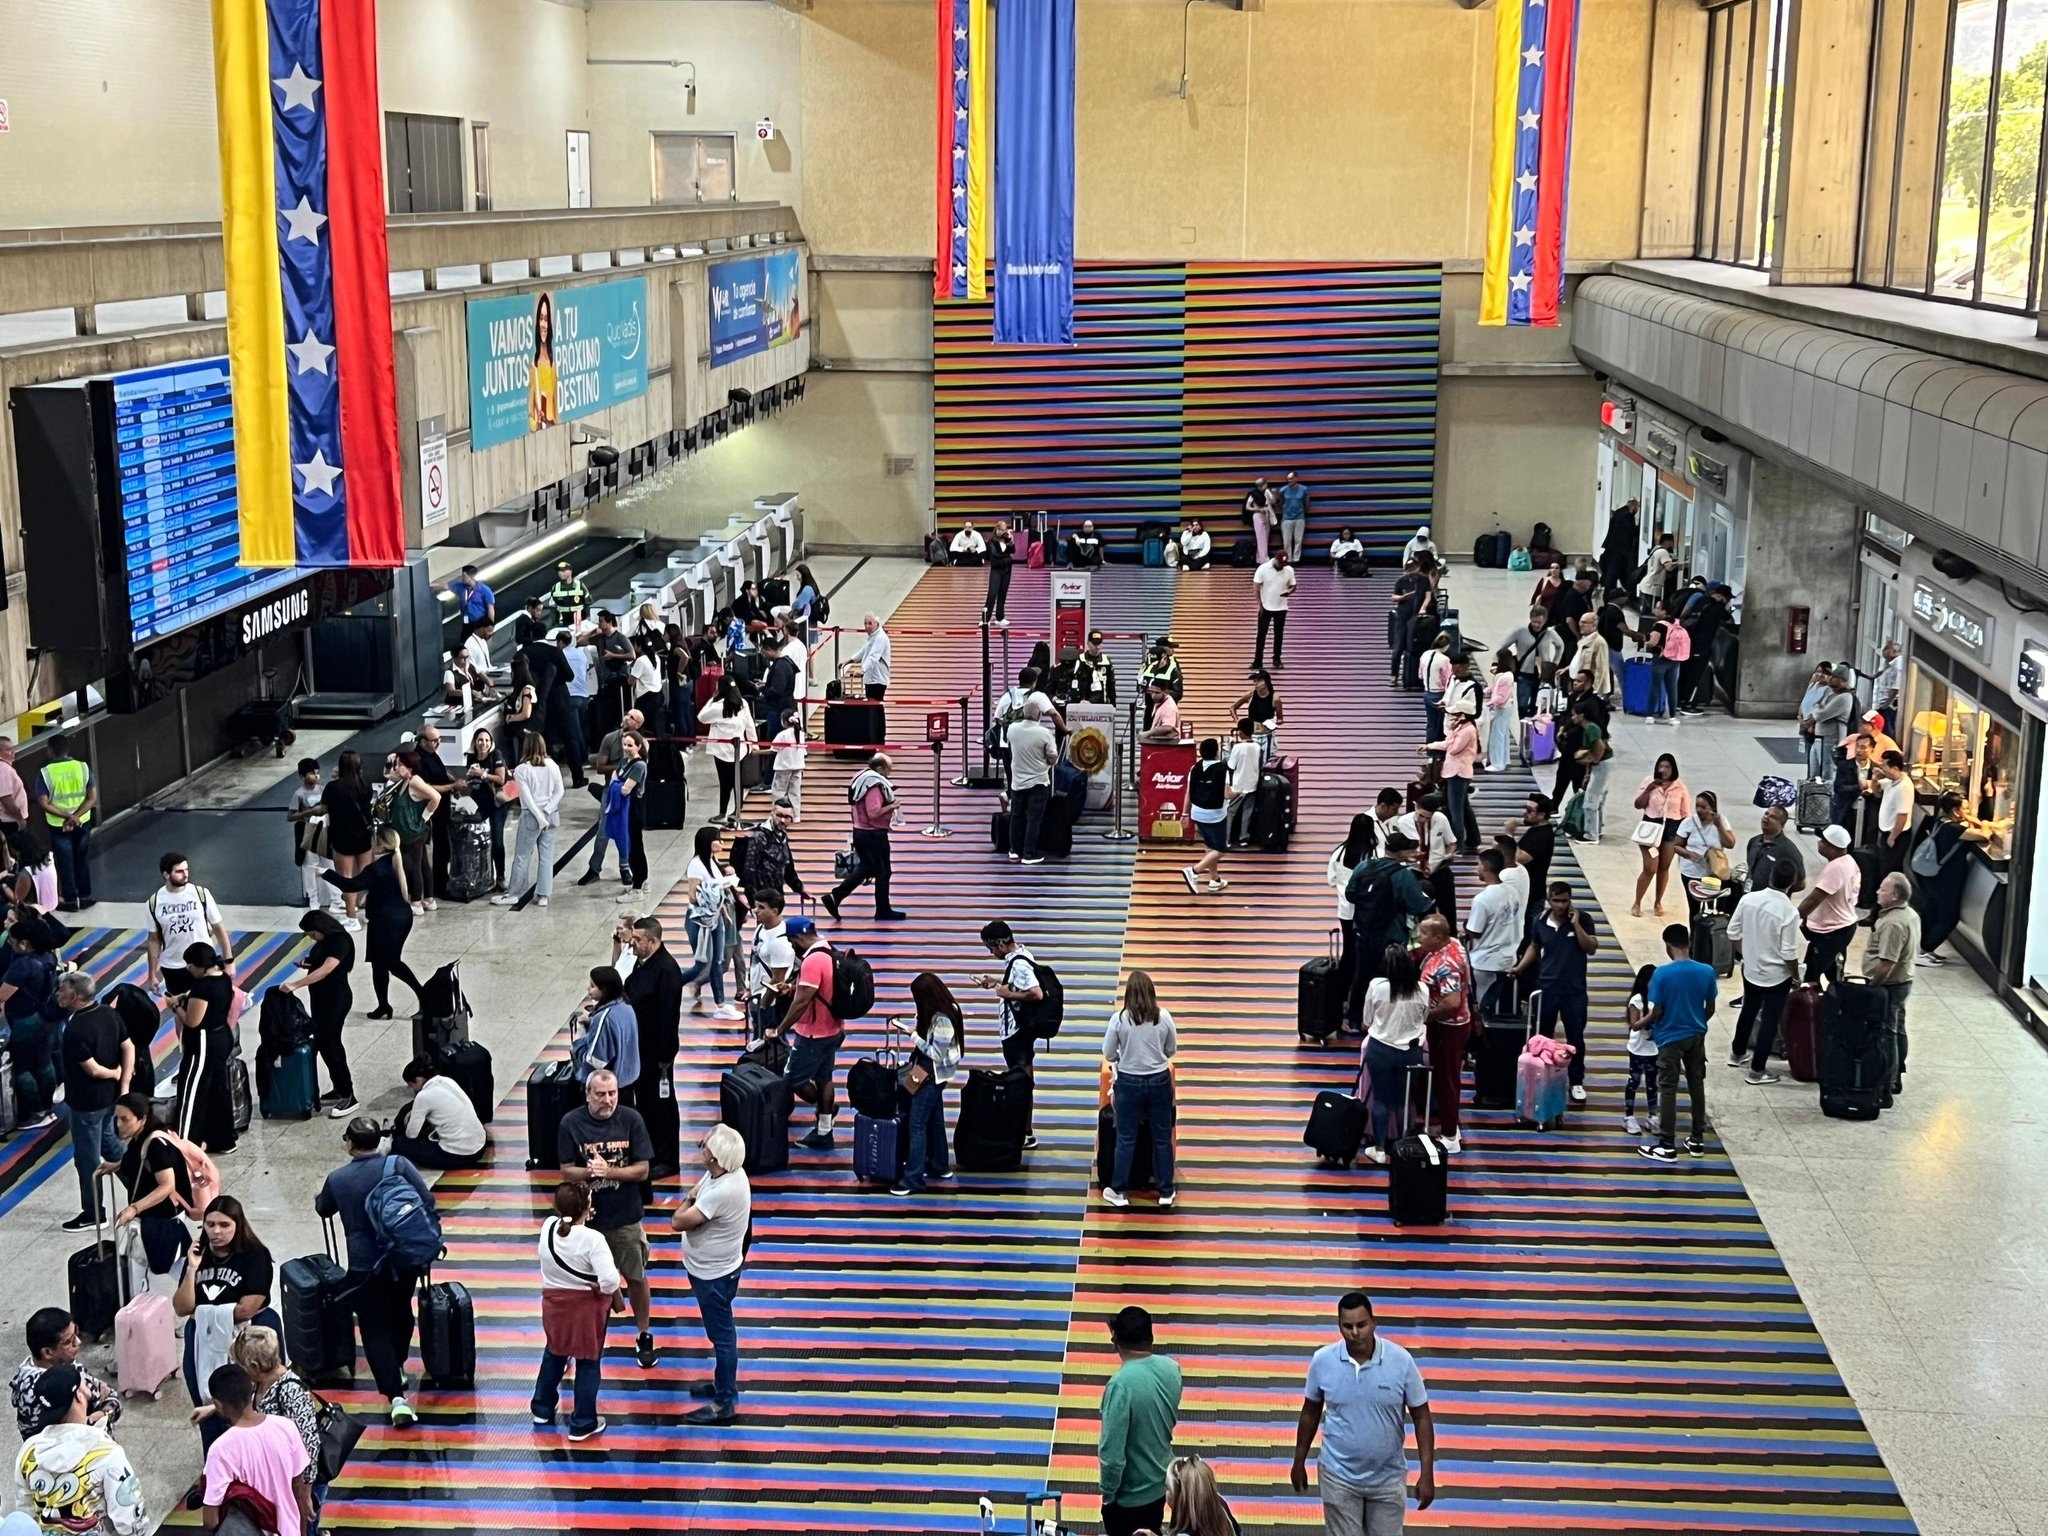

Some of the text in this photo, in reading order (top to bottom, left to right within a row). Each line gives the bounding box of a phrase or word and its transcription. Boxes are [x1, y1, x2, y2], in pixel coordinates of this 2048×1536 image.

[489, 315, 533, 357] VAMOS
[555, 306, 578, 340] A TU
[555, 335, 600, 374] PRÓXIMO
[482, 355, 530, 398] JUNTOS
[557, 371, 600, 414] DESTINO
[242, 588, 308, 644] SAMSUNG
[1152, 771, 1184, 783] Avior
[216, 1267, 242, 1287] VIBES
